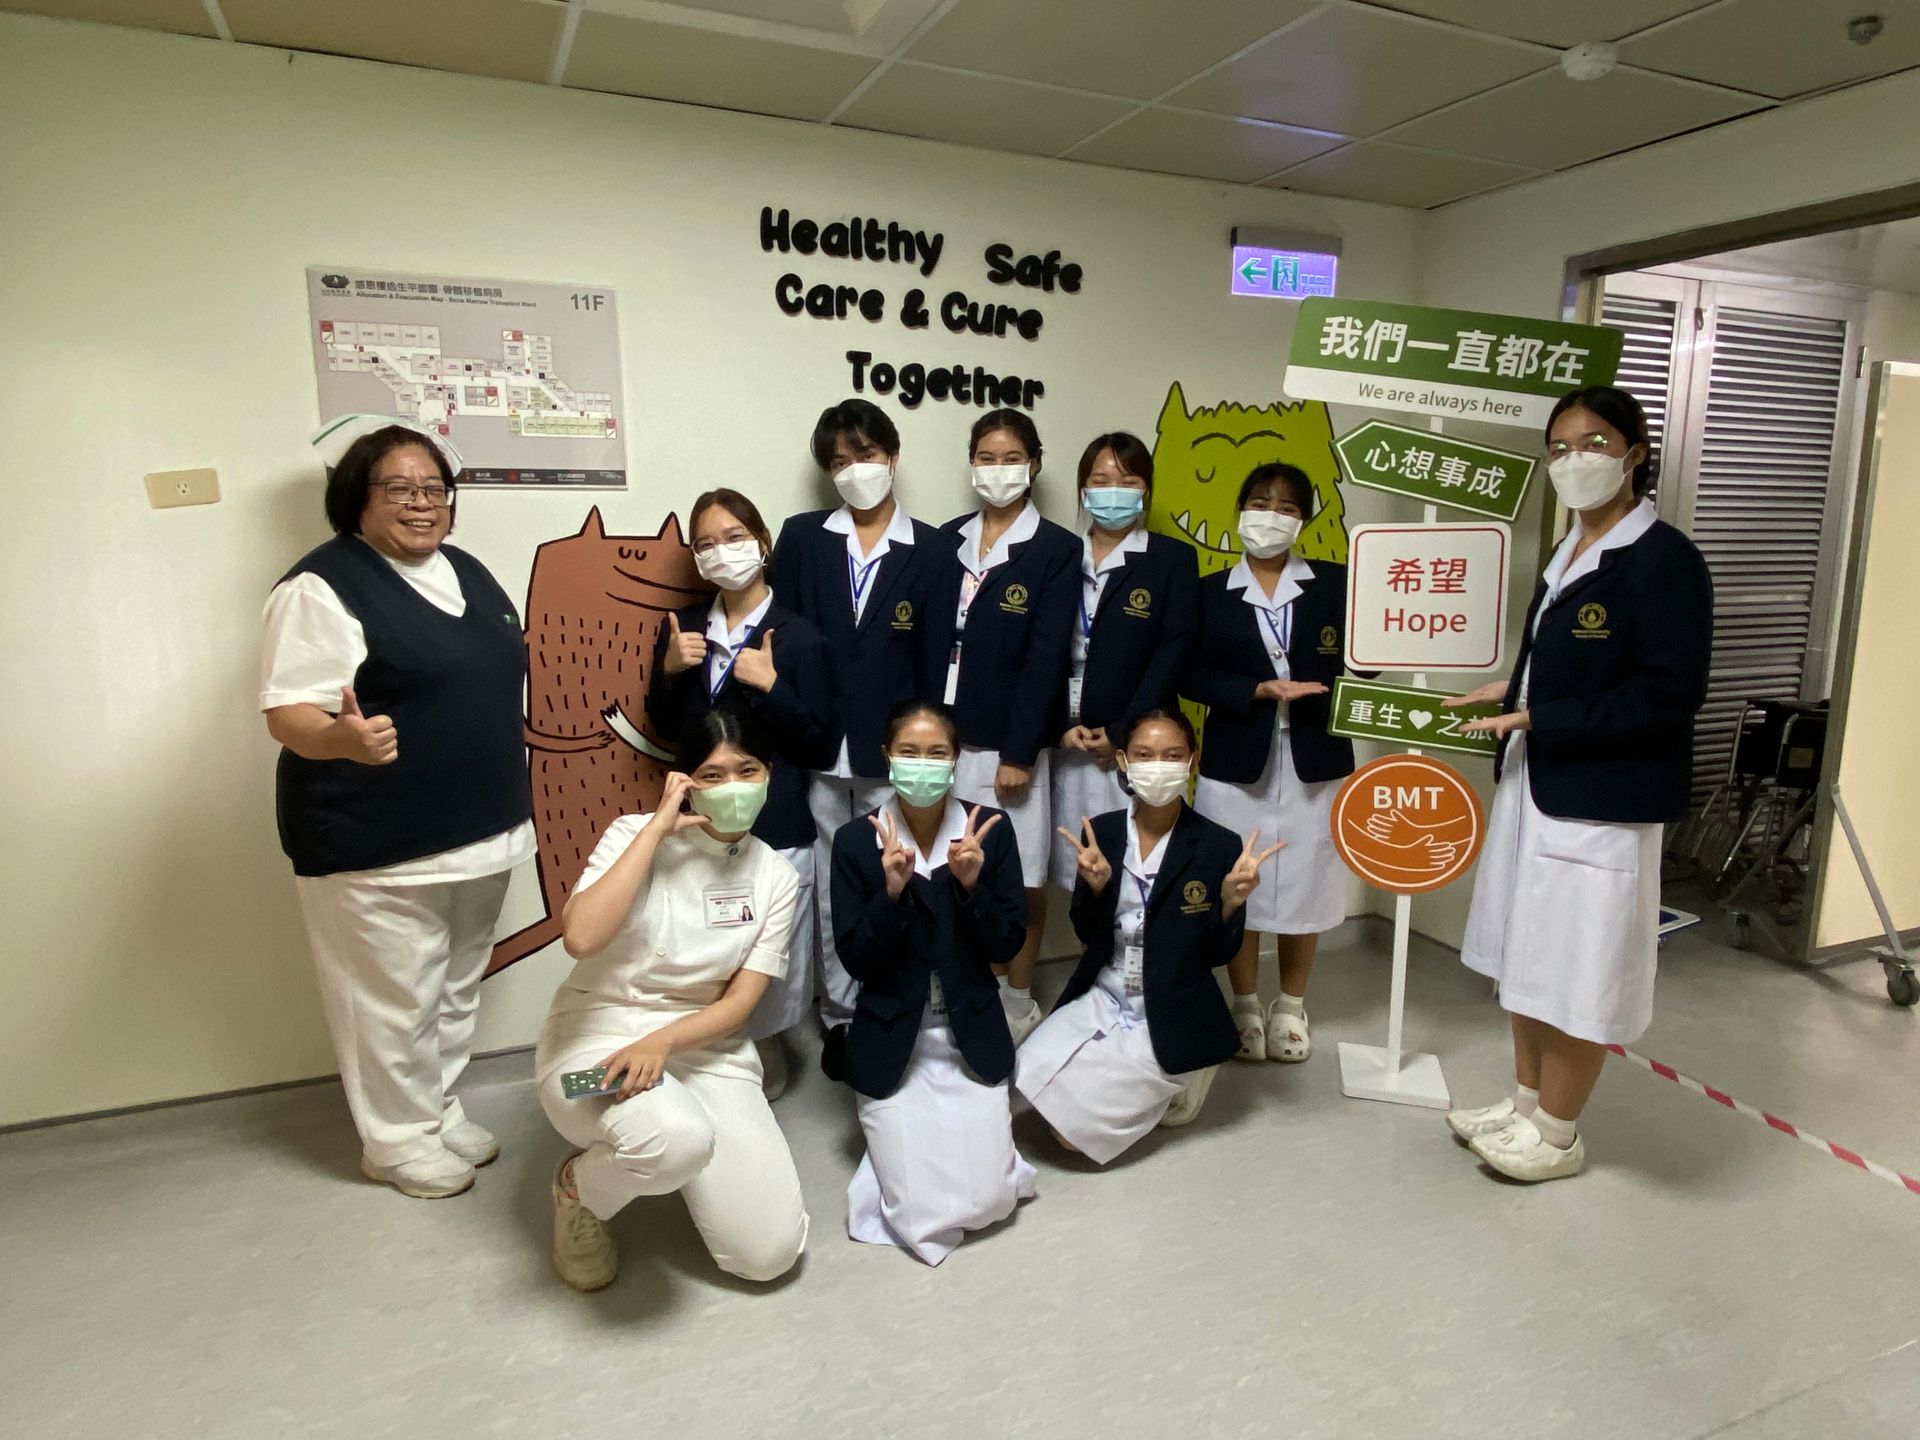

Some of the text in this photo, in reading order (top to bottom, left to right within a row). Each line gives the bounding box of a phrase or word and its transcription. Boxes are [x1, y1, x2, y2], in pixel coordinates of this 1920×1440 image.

[760, 206, 1082, 292] Healthy Safe
[570, 293, 605, 311] 11F
[775, 273, 1043, 339] Care & Cure
[1319, 315, 1590, 386] 我們一直都在
[846, 350, 1045, 408] Together
[1358, 382, 1523, 417] We are always here
[1364, 440, 1506, 499] 心想事成
[1386, 557, 1467, 594] 希望
[1384, 608, 1467, 639] Hope
[1347, 699, 1403, 729] 重生
[1373, 785, 1445, 810] BMT
